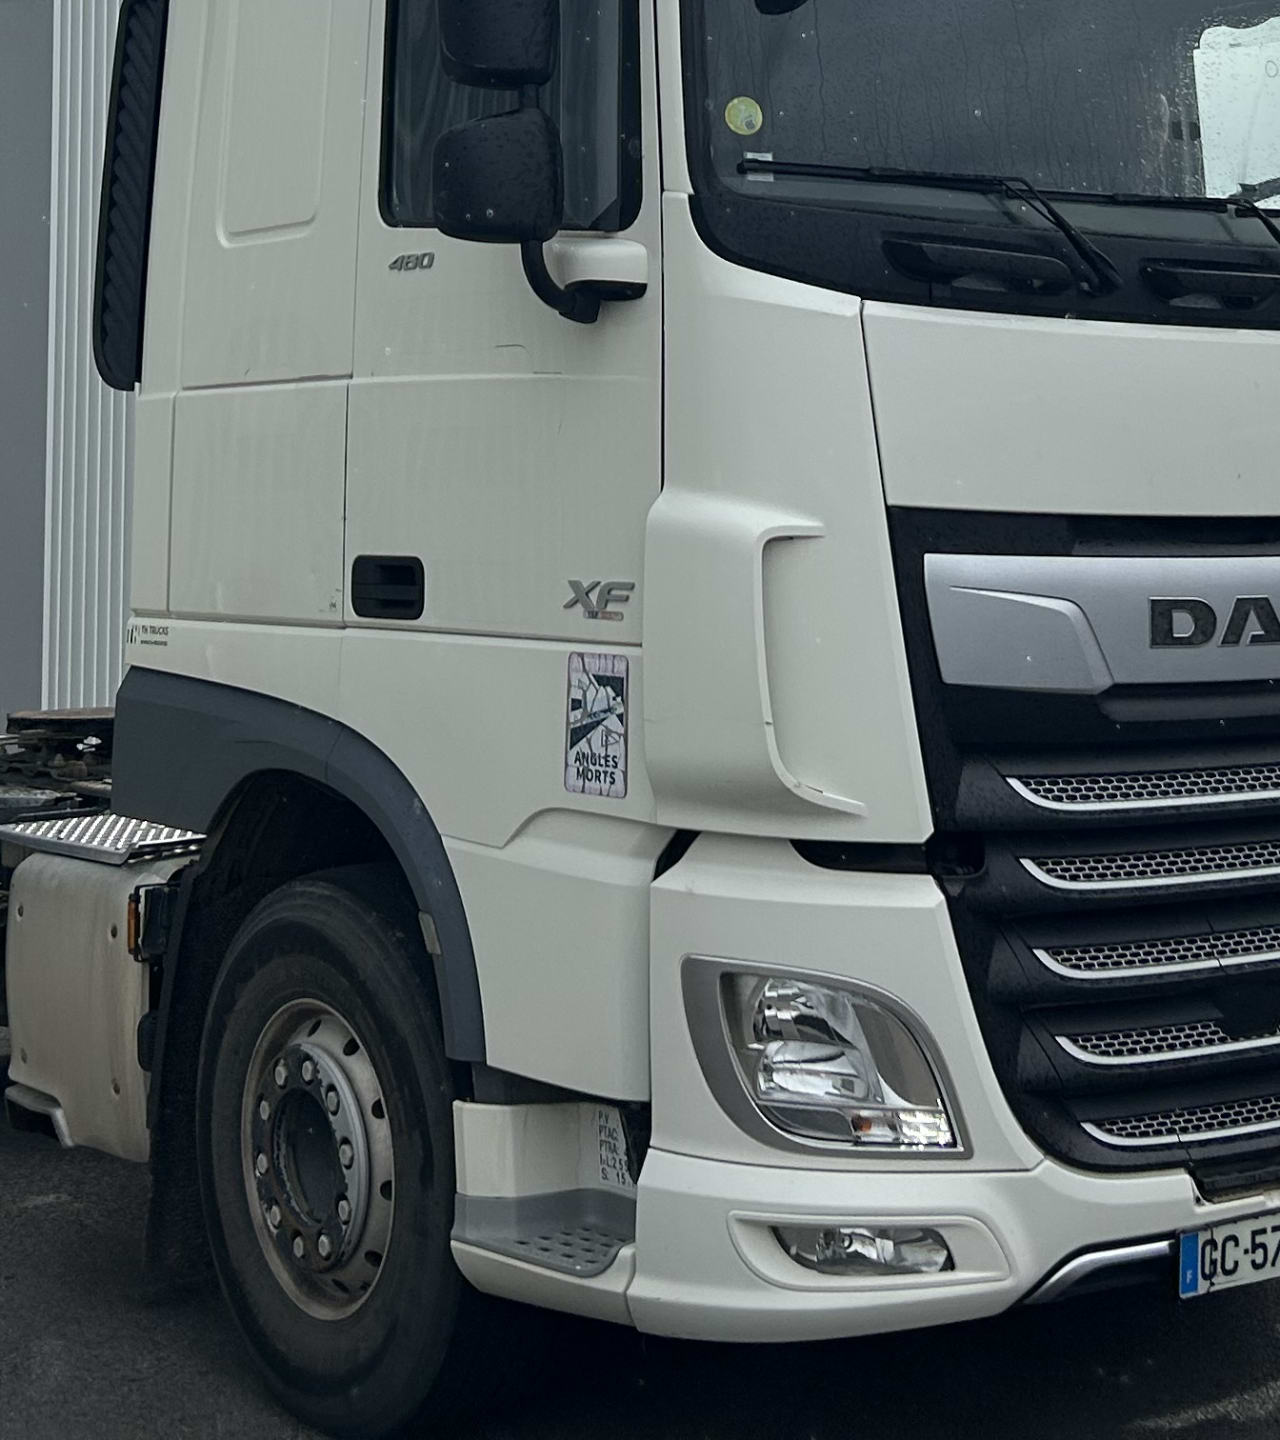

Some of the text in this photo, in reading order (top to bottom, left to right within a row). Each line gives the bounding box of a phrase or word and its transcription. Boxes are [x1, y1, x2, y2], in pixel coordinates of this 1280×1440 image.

[563, 579, 635, 609] XF
[574, 750, 619, 769] ANGLES
[576, 767, 616, 786] MORTS
